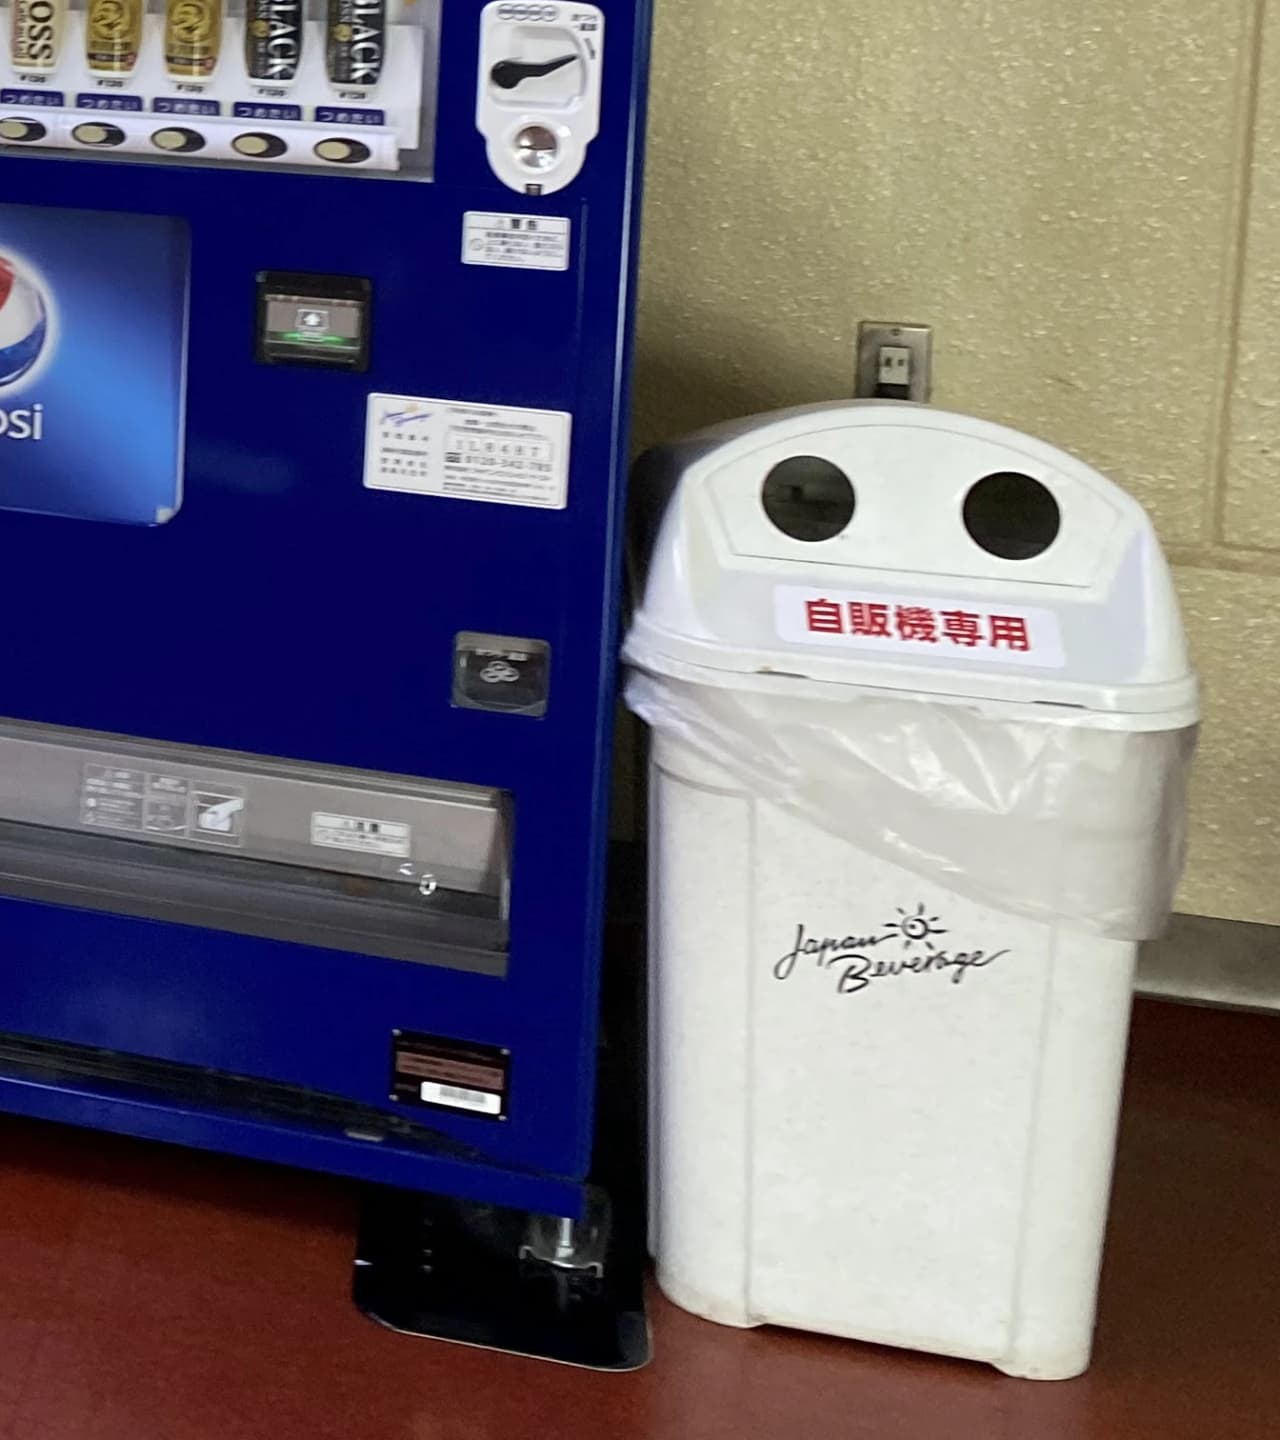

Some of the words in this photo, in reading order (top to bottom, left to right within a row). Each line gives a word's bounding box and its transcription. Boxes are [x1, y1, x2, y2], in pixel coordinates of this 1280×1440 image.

[804, 598, 1031, 652] 自販機専用
[774, 923, 899, 981] Japan
[831, 948, 1011, 994] Beverage
